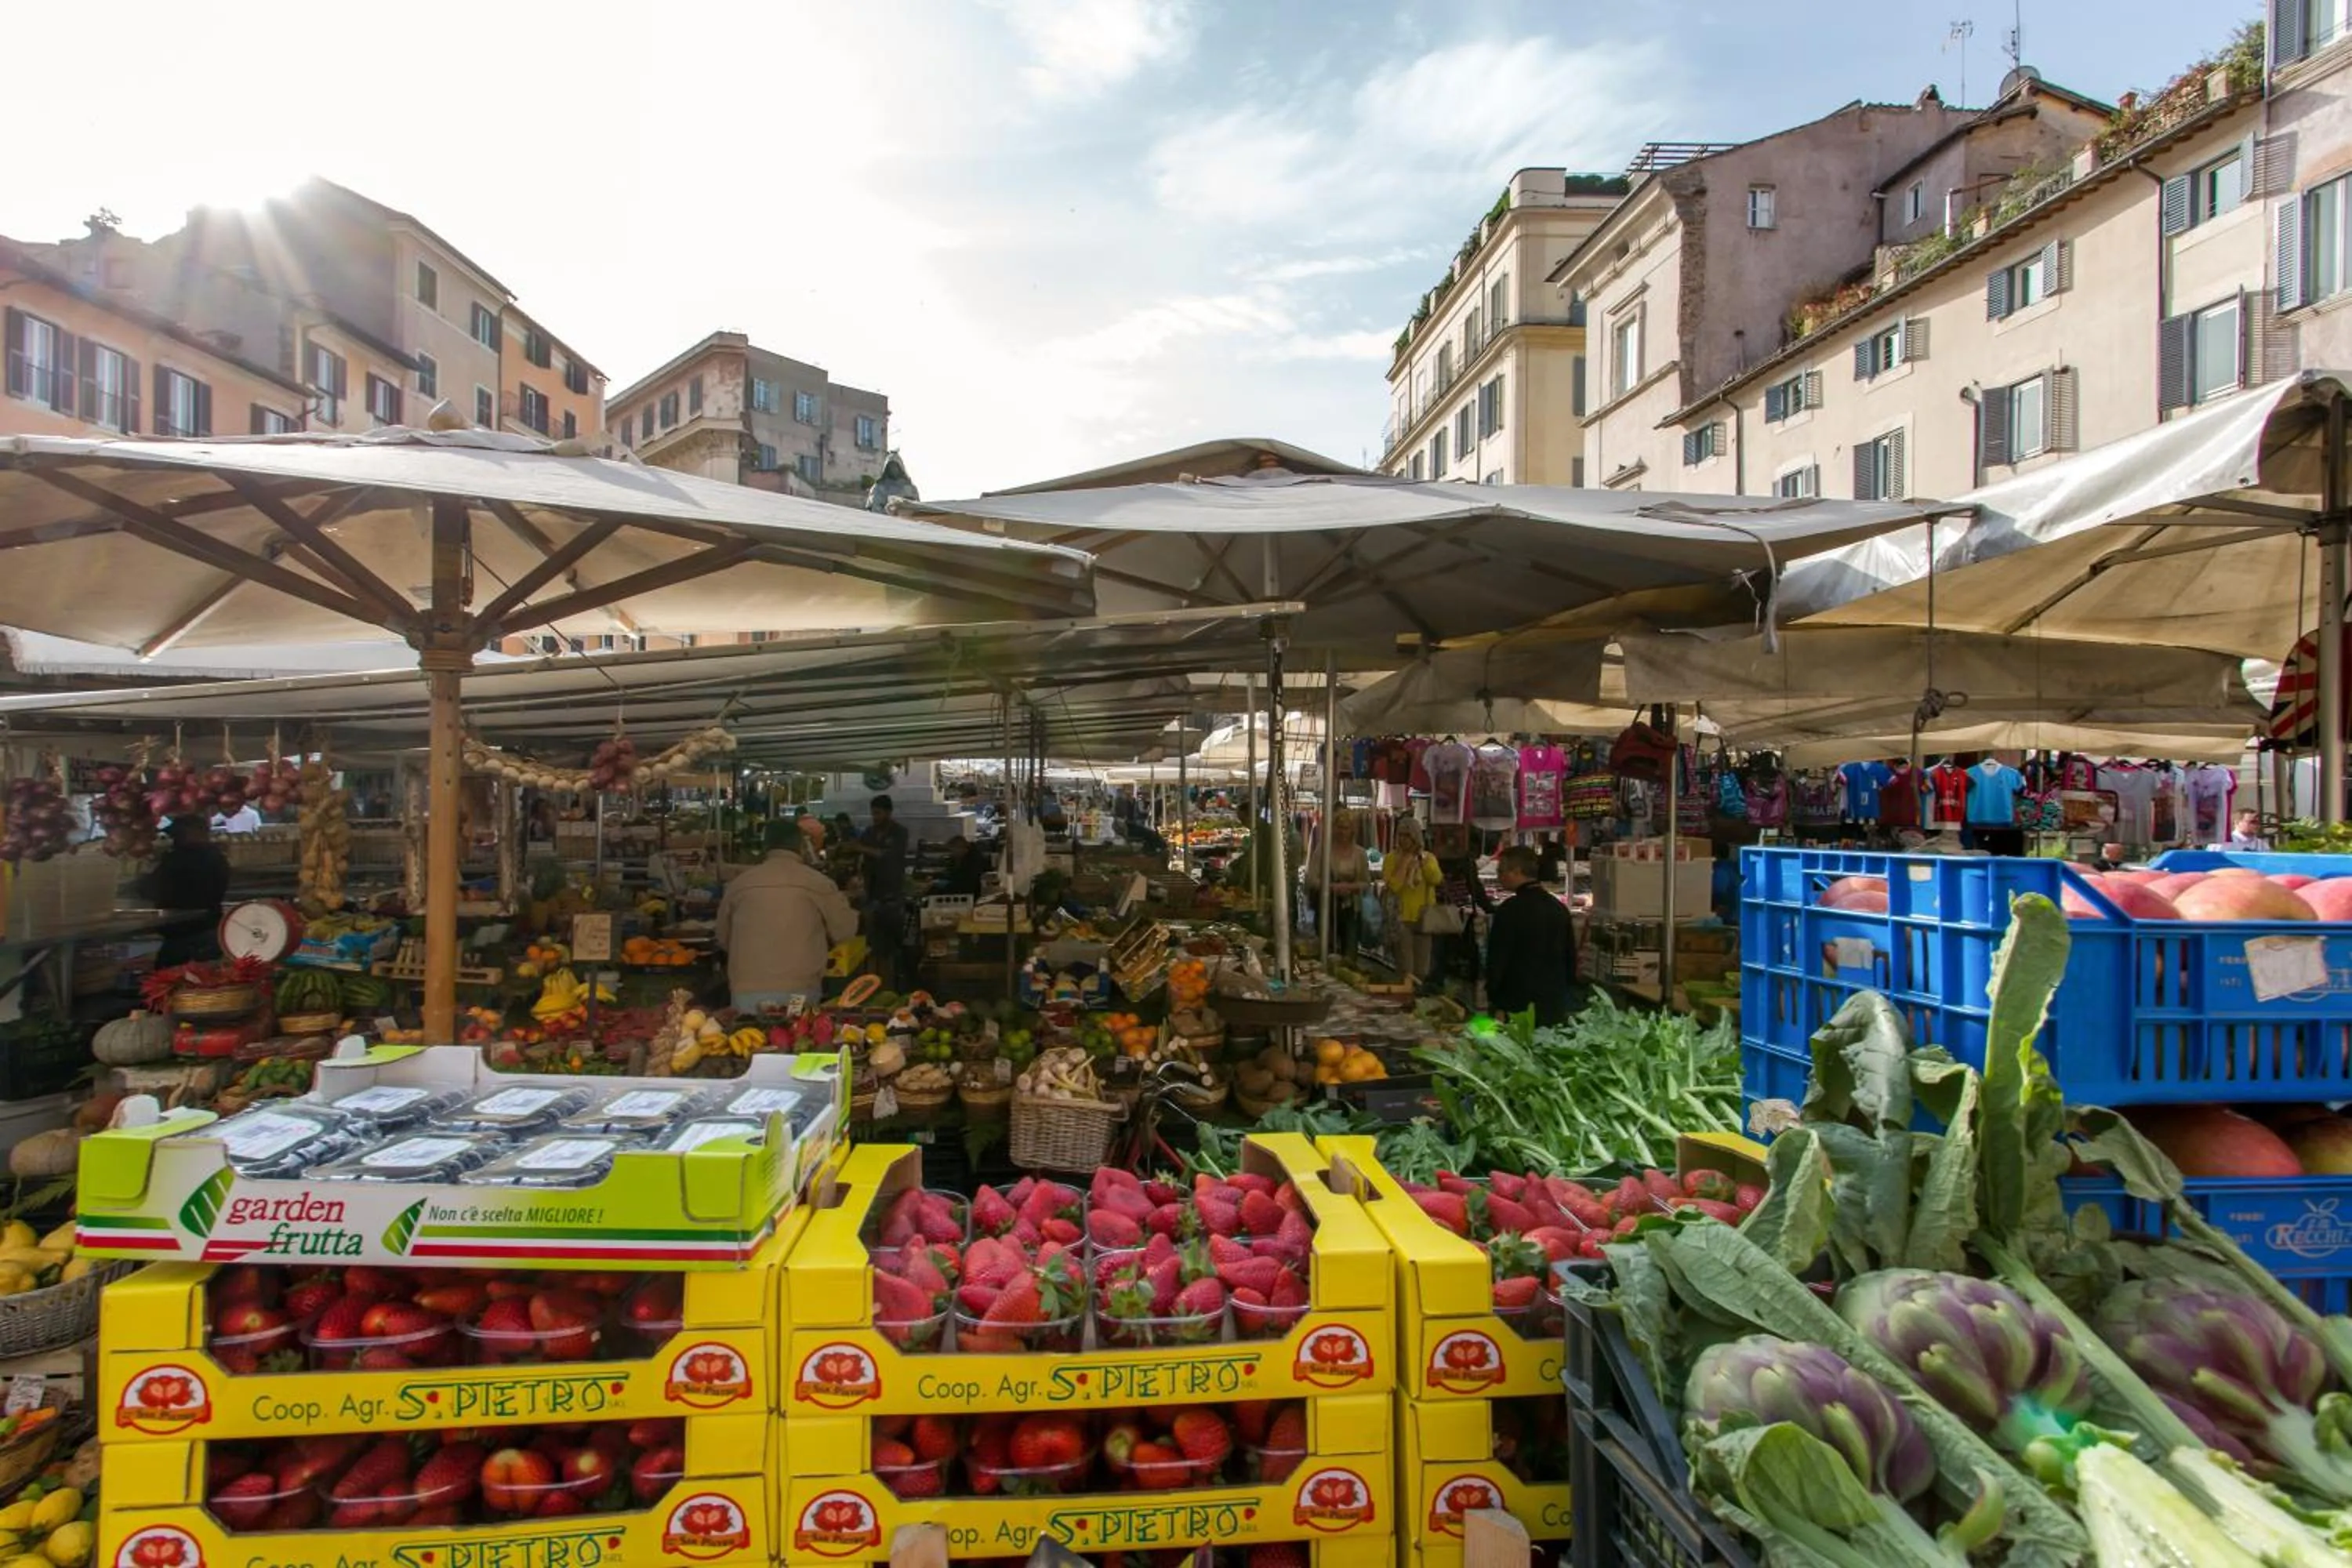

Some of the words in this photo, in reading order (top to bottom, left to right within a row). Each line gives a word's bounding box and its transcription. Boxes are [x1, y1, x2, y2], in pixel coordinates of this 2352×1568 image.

[225, 1191, 346, 1225] garden
[428, 1205, 458, 1221] Non
[481, 1206, 523, 1222] scelta
[263, 1222, 364, 1255] frutta
[918, 1374, 986, 1405] Coop.
[996, 1373, 1042, 1403] Agr.
[252, 1395, 328, 1426] Coop.
[339, 1393, 389, 1424] Agr.
[946, 1526, 985, 1551] op.
[995, 1519, 1038, 1549] Agr
